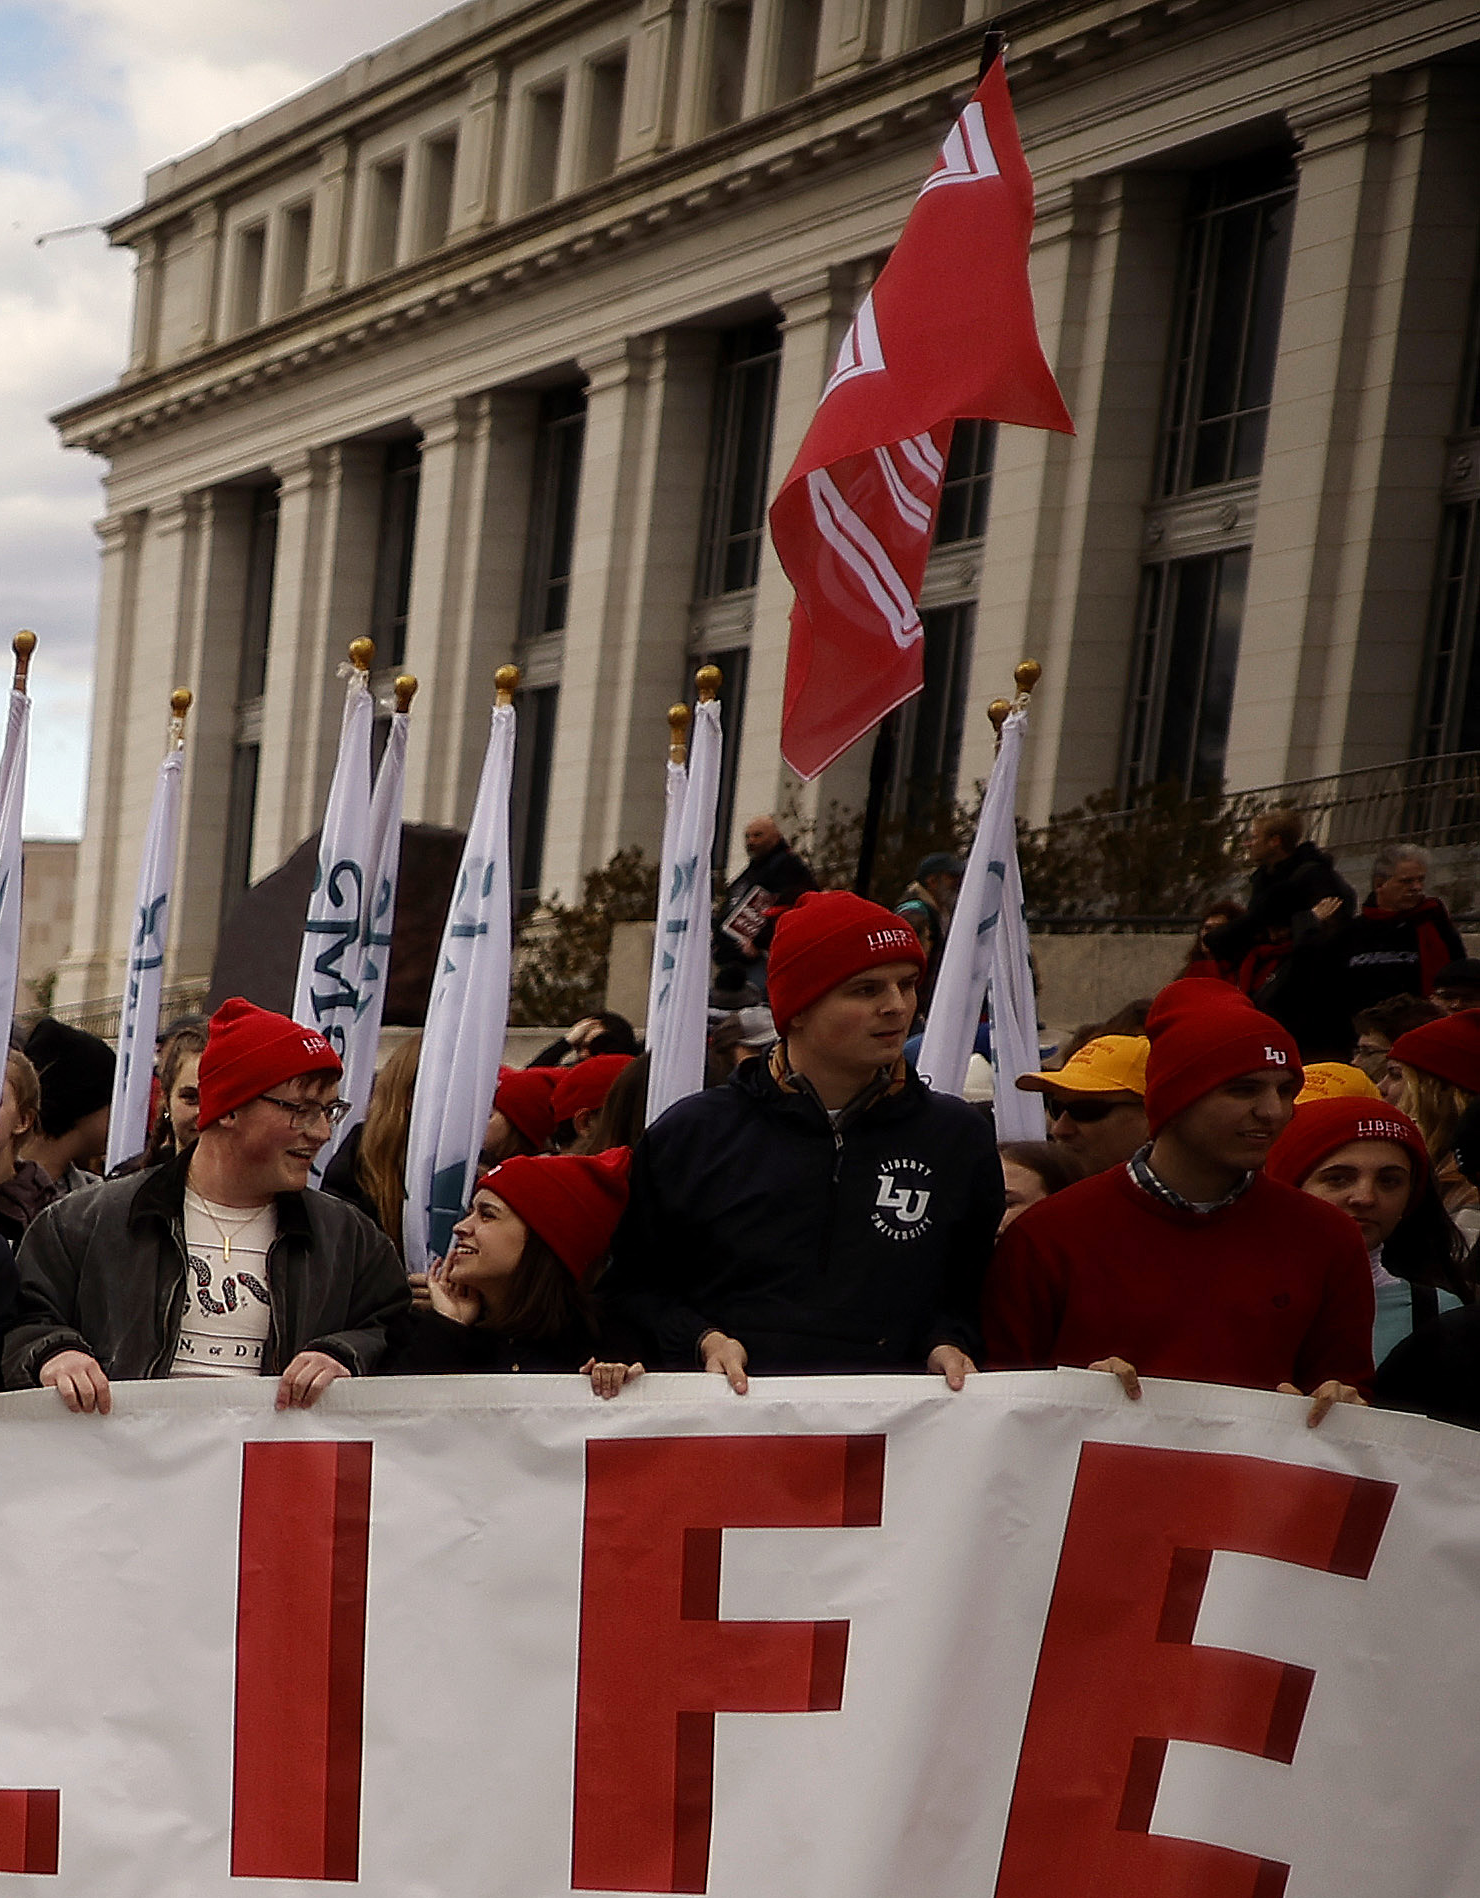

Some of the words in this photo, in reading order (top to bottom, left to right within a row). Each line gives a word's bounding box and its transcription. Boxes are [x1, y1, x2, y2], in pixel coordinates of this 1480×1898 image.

[1265, 1046, 1287, 1066] LU
[880, 1158, 933, 1177] LIBERTY
[875, 1174, 932, 1223] LU
[870, 1212, 933, 1241] UNIVERSITY
[235, 1344, 261, 1358] DI
